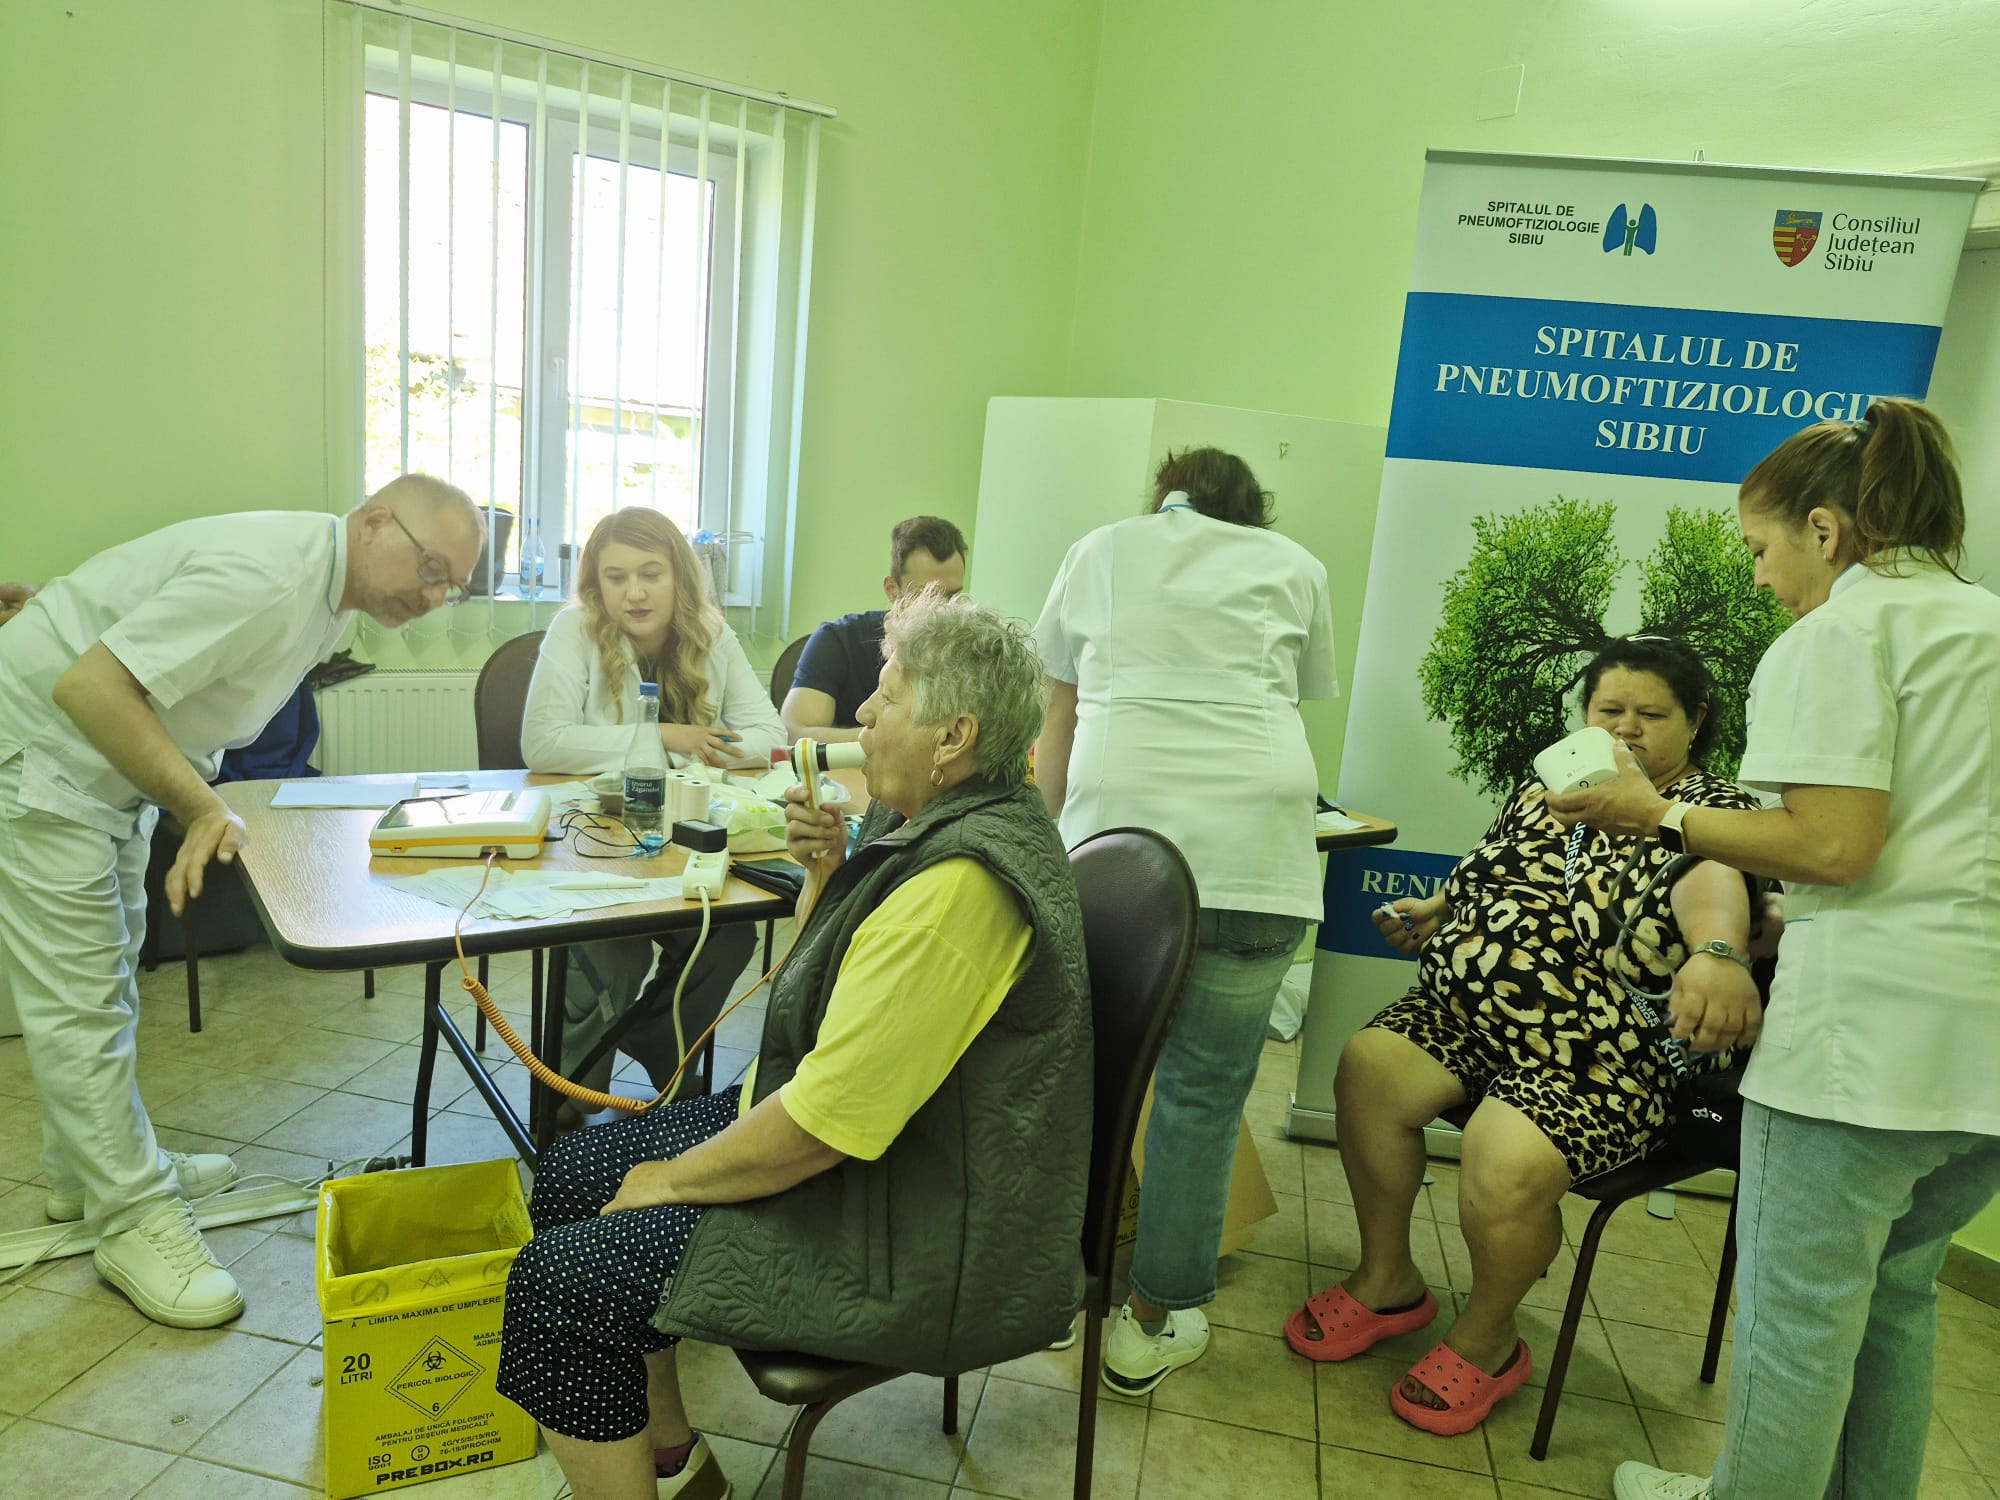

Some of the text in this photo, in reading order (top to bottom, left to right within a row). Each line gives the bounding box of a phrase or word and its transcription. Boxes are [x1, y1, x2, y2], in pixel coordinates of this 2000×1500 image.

[1487, 200, 1575, 217] SPITALUL DE
[1458, 214, 1600, 234] PNEUMOFTIZIOLOGIE
[1832, 213, 1921, 235] Consiliul
[1508, 233, 1544, 246] SIBIU
[1826, 233, 1915, 256] Județean
[1824, 252, 1874, 272] Sibiu
[1534, 324, 1800, 373] SPITALUL DE
[1595, 418, 1708, 456] SIBIU
[368, 1295, 502, 1326] LIMITA MAXIMA DE UMPLERE
[473, 1331, 495, 1341] MASA
[342, 1353, 371, 1374] 20
[340, 1371, 373, 1385] LITRI
[396, 1370, 474, 1390] PERICOL BIOLOGIC
[432, 1402, 440, 1412] 6
[375, 1427, 412, 1441] AMBALAJ
[381, 1435, 413, 1447] PENTRU
[450, 1420, 489, 1433] MEDICALE
[368, 1453, 392, 1466] ISO
[376, 1450, 494, 1485] PREBOX.RO
